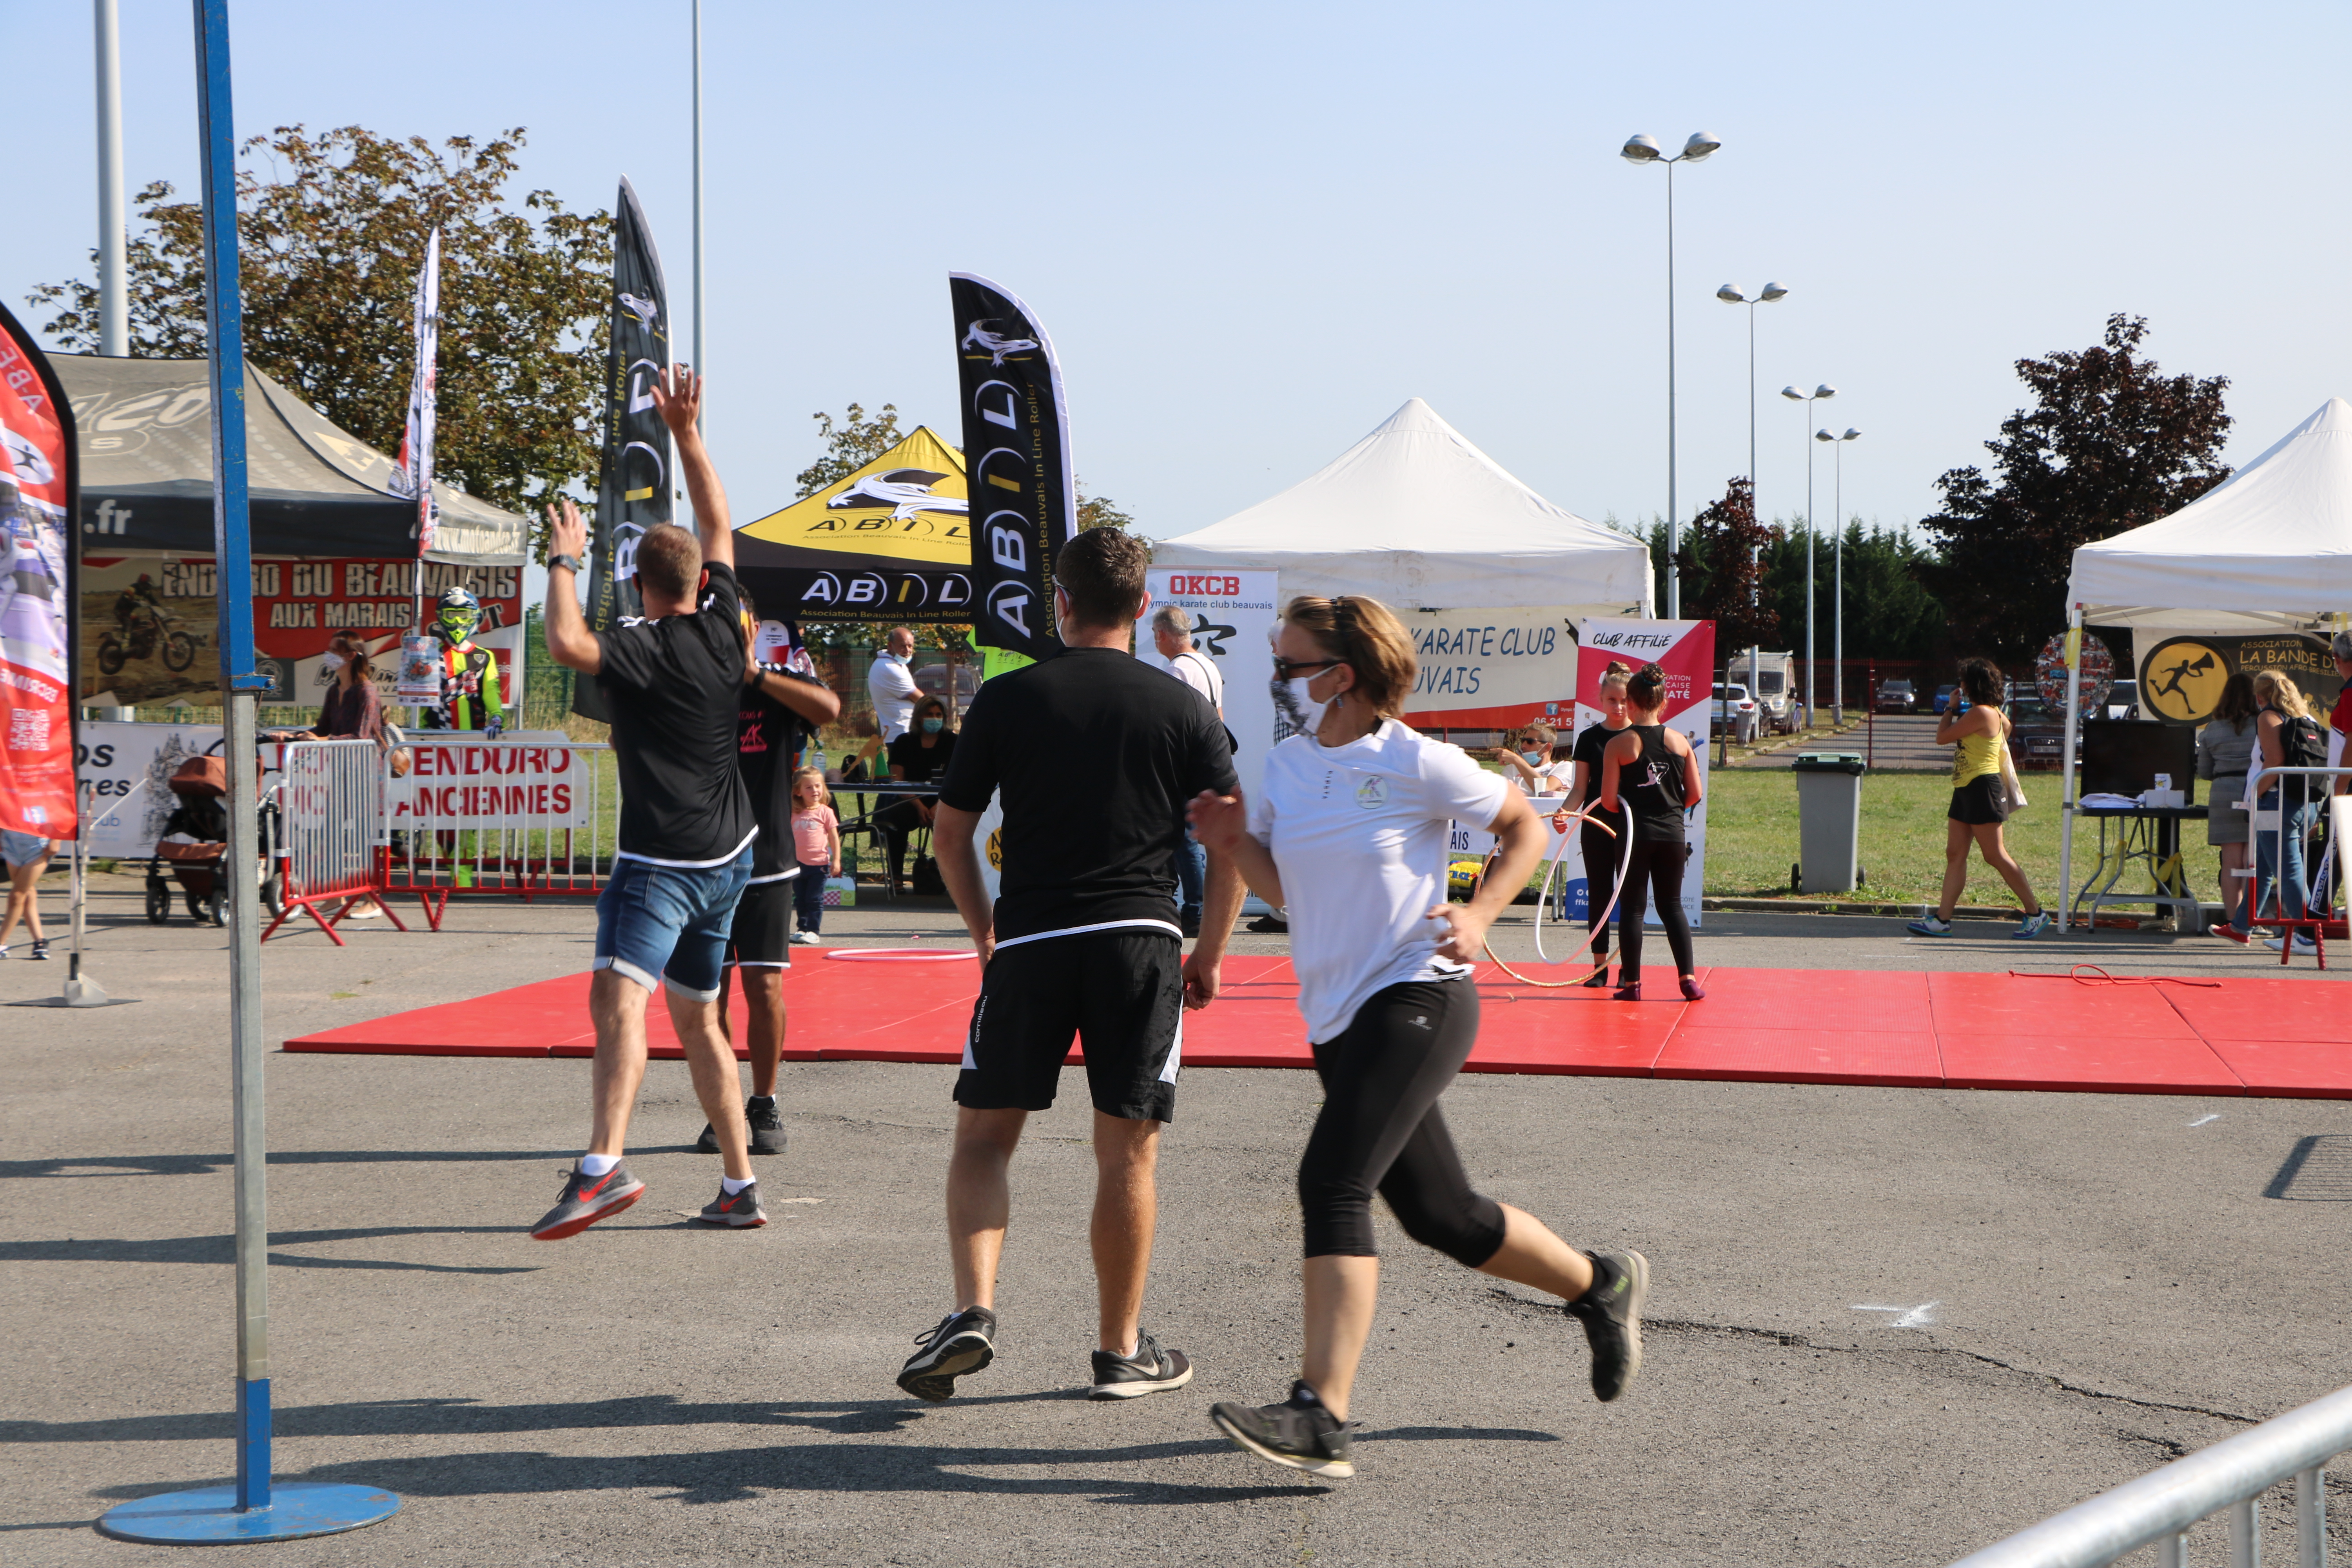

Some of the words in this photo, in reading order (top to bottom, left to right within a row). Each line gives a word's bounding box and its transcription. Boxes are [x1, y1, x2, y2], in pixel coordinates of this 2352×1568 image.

[1026, 382, 1040, 423] Roller
[1032, 429, 1042, 458] Line
[1034, 464, 1043, 477] In
[1035, 482, 1049, 548] Beauvais
[292, 563, 333, 597] DU
[1170, 575, 1240, 595] OKCB
[1041, 553, 1054, 637] Association
[1180, 600, 1207, 608] karate
[1233, 600, 1272, 609] beauvais
[269, 603, 316, 628] AUX
[325, 603, 411, 628] MARAIS
[1501, 627, 1555, 656] CLUB
[1593, 632, 1623, 647] CLUB
[2241, 640, 2303, 648] ASSOCIATION
[2239, 651, 2260, 664] LA
[2267, 649, 2318, 666] BANDE
[1550, 717, 1562, 726] 21
[414, 747, 570, 775] ENDURO
[975, 996, 988, 1043] cornilleau
